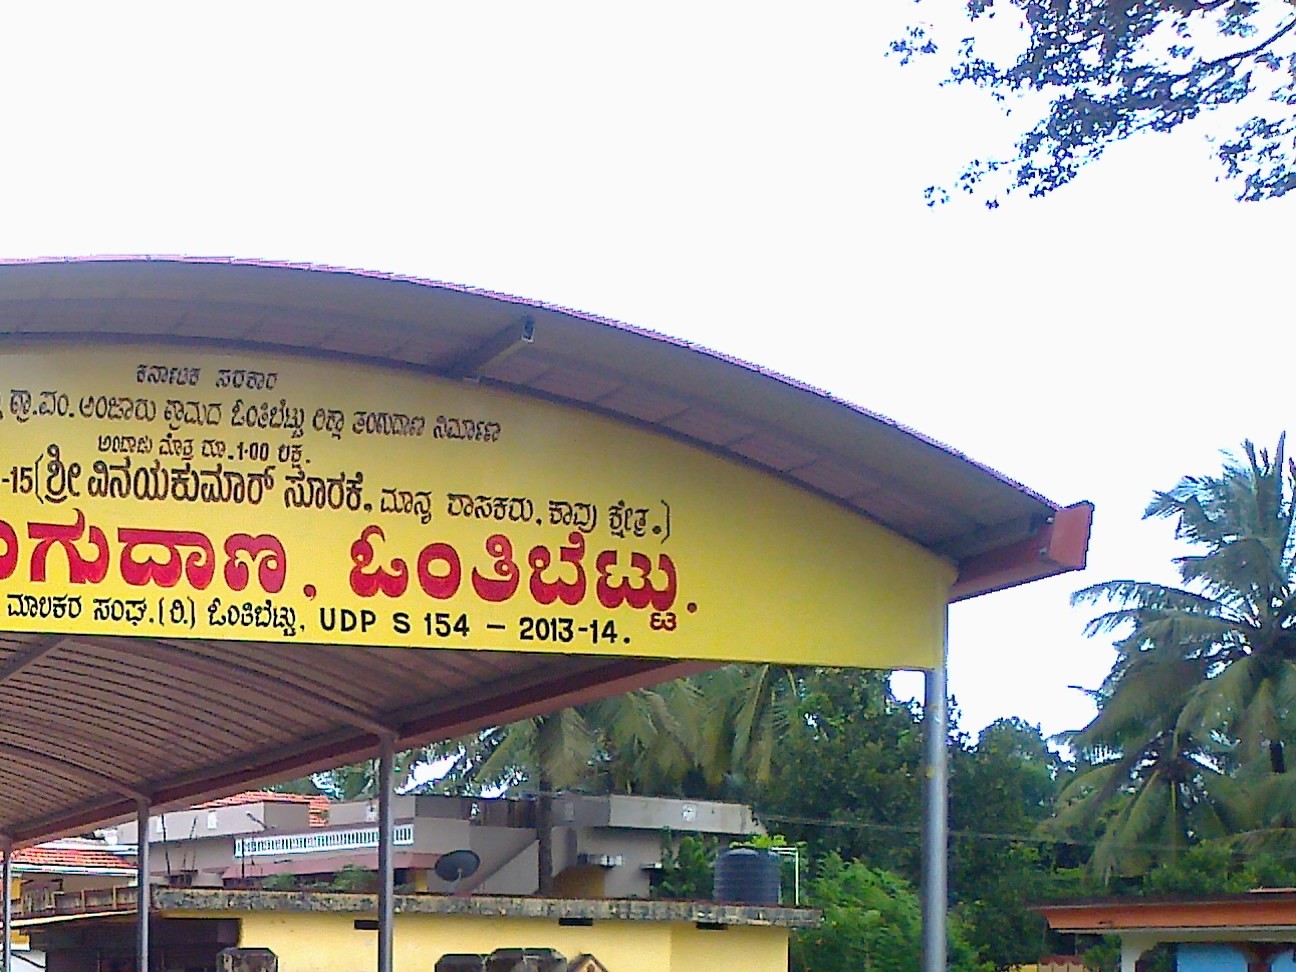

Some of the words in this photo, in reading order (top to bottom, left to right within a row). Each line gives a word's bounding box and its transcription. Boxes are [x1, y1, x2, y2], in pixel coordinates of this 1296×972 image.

[136, 364, 201, 387] ಕರ್ನಾಟಕ
[215, 368, 279, 391] ಸರಕಾರ
[79, 394, 157, 422] ಅಂಜಾರು
[163, 399, 222, 430] ಗ್ರಾಮದ
[87, 455, 276, 505] ವಿನಯಕುಮಾರ್
[380, 487, 432, 525] ಮಾನ್ಯ
[319, 607, 377, 633] UDP
[393, 612, 411, 633] S
[424, 612, 470, 637] 154
